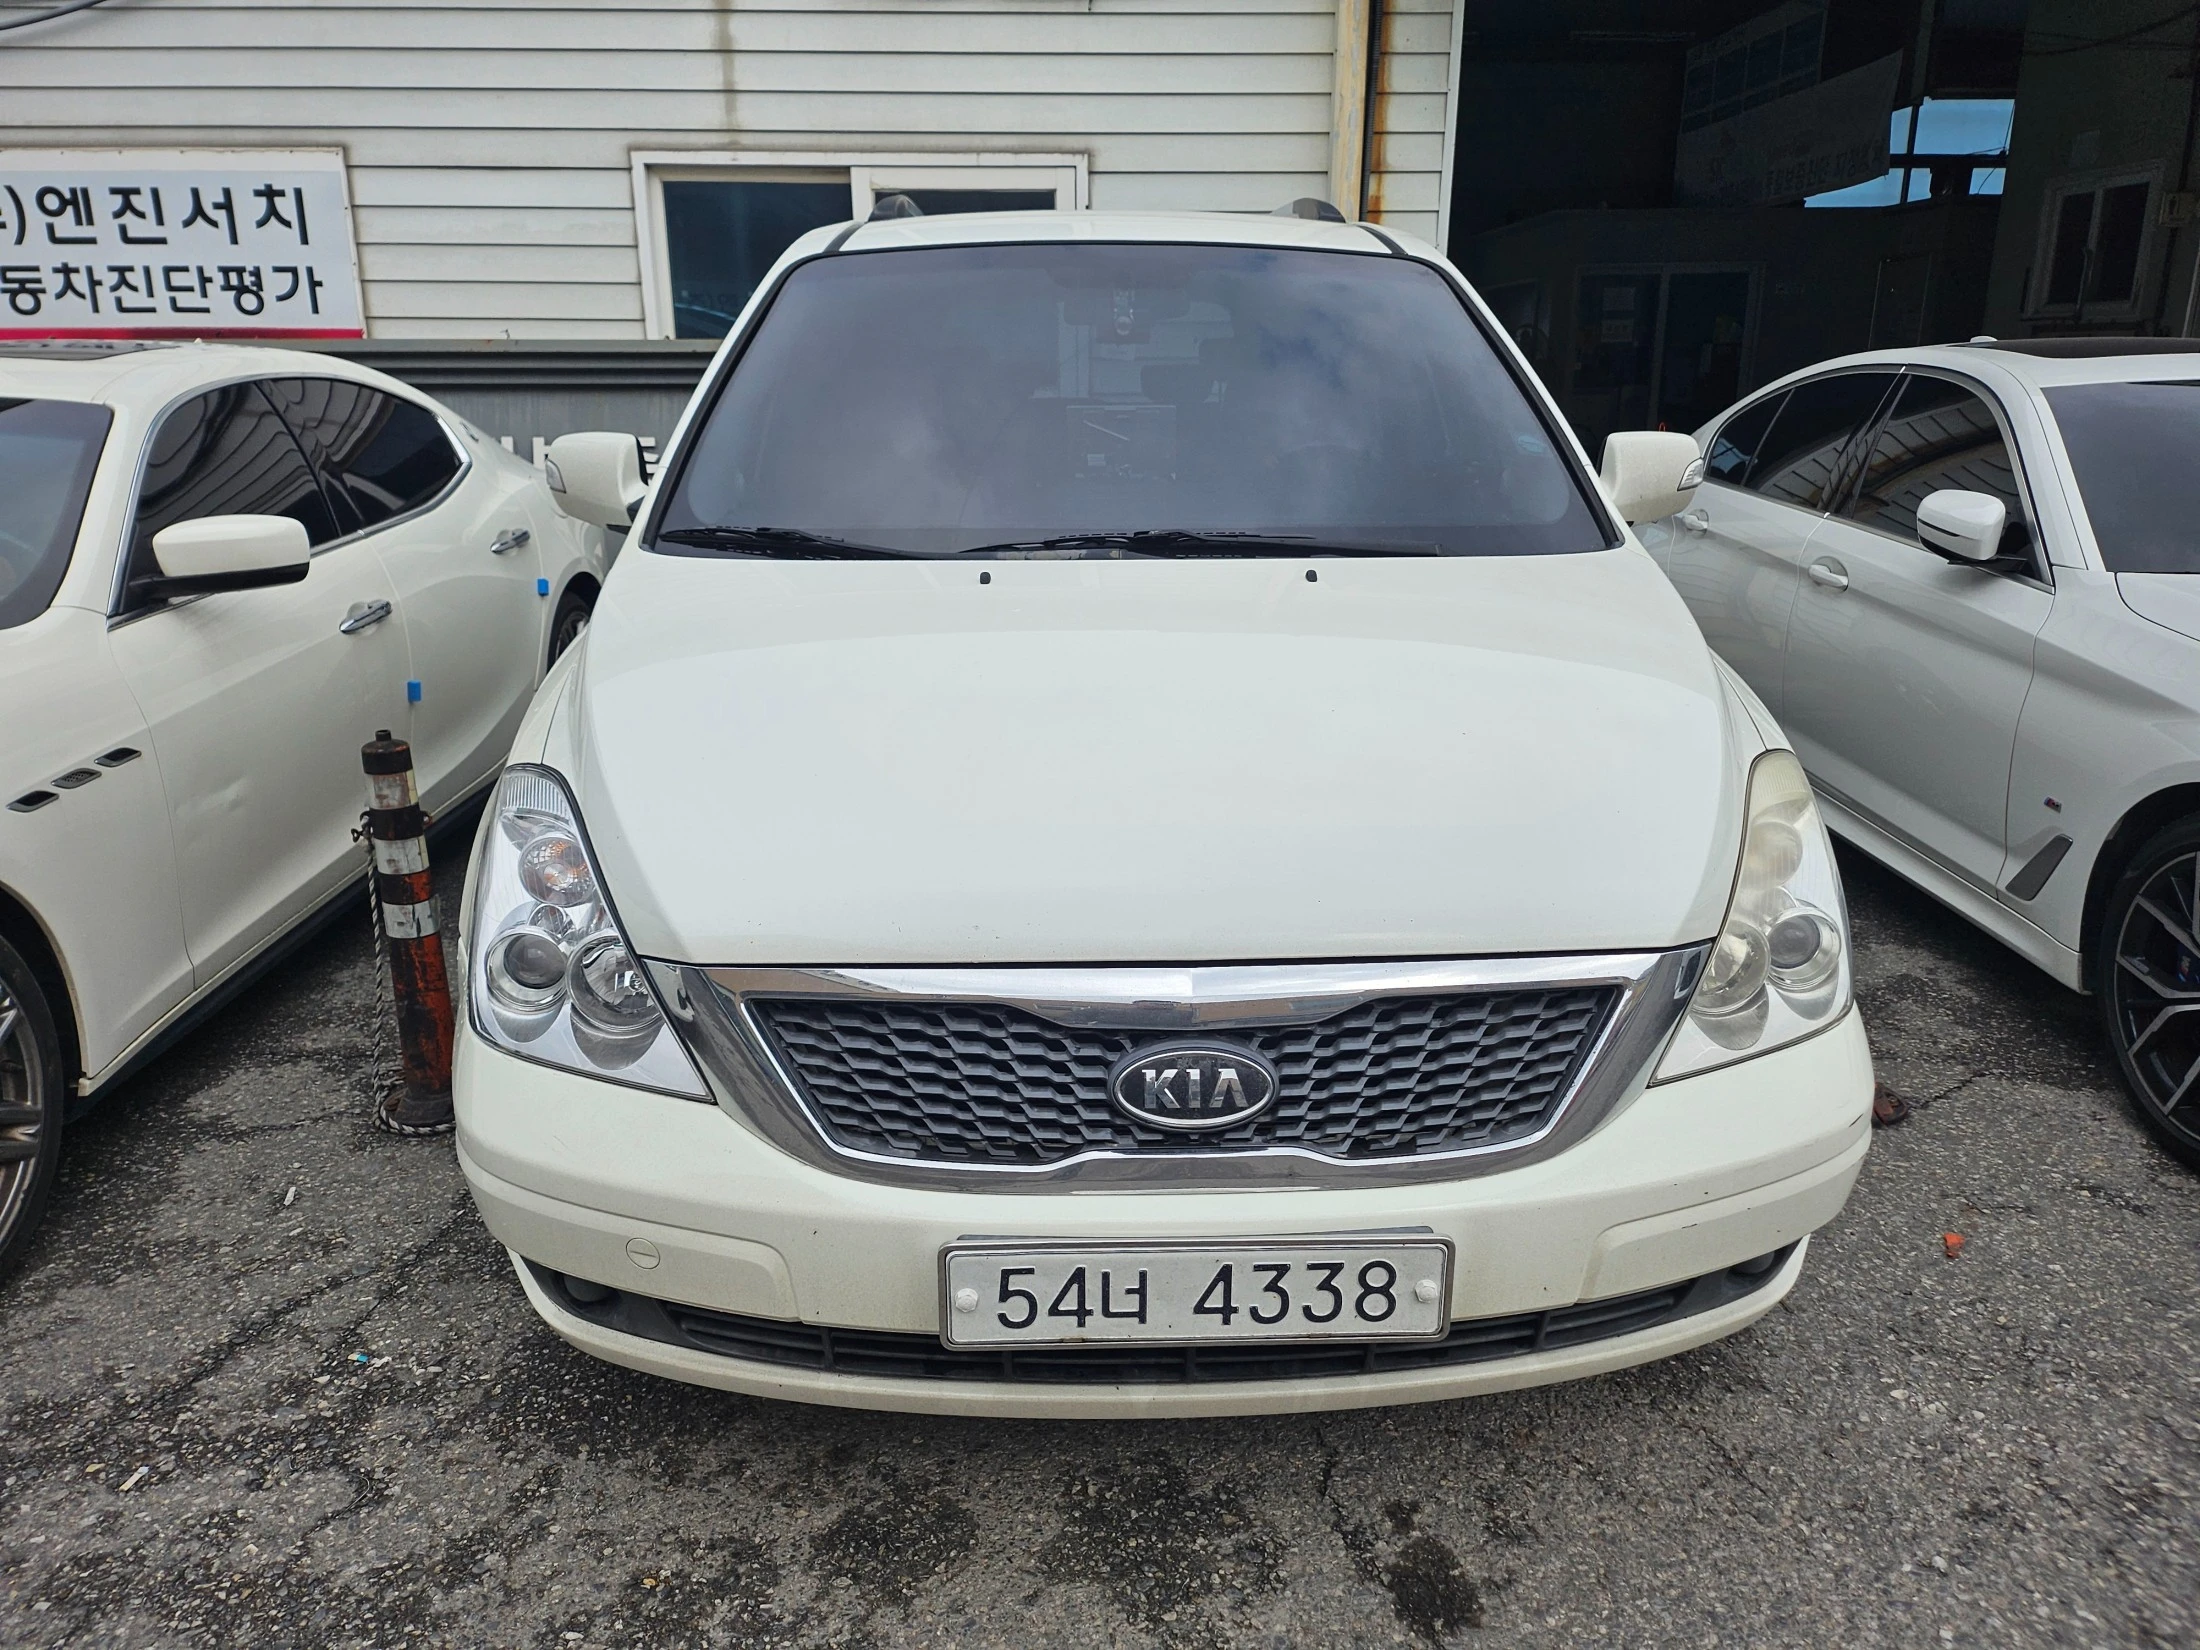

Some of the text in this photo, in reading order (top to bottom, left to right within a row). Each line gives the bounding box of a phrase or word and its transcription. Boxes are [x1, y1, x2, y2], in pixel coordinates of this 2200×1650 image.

[1141, 1068, 1249, 1109] KIA
[997, 1260, 1397, 1330] 54너 4338
